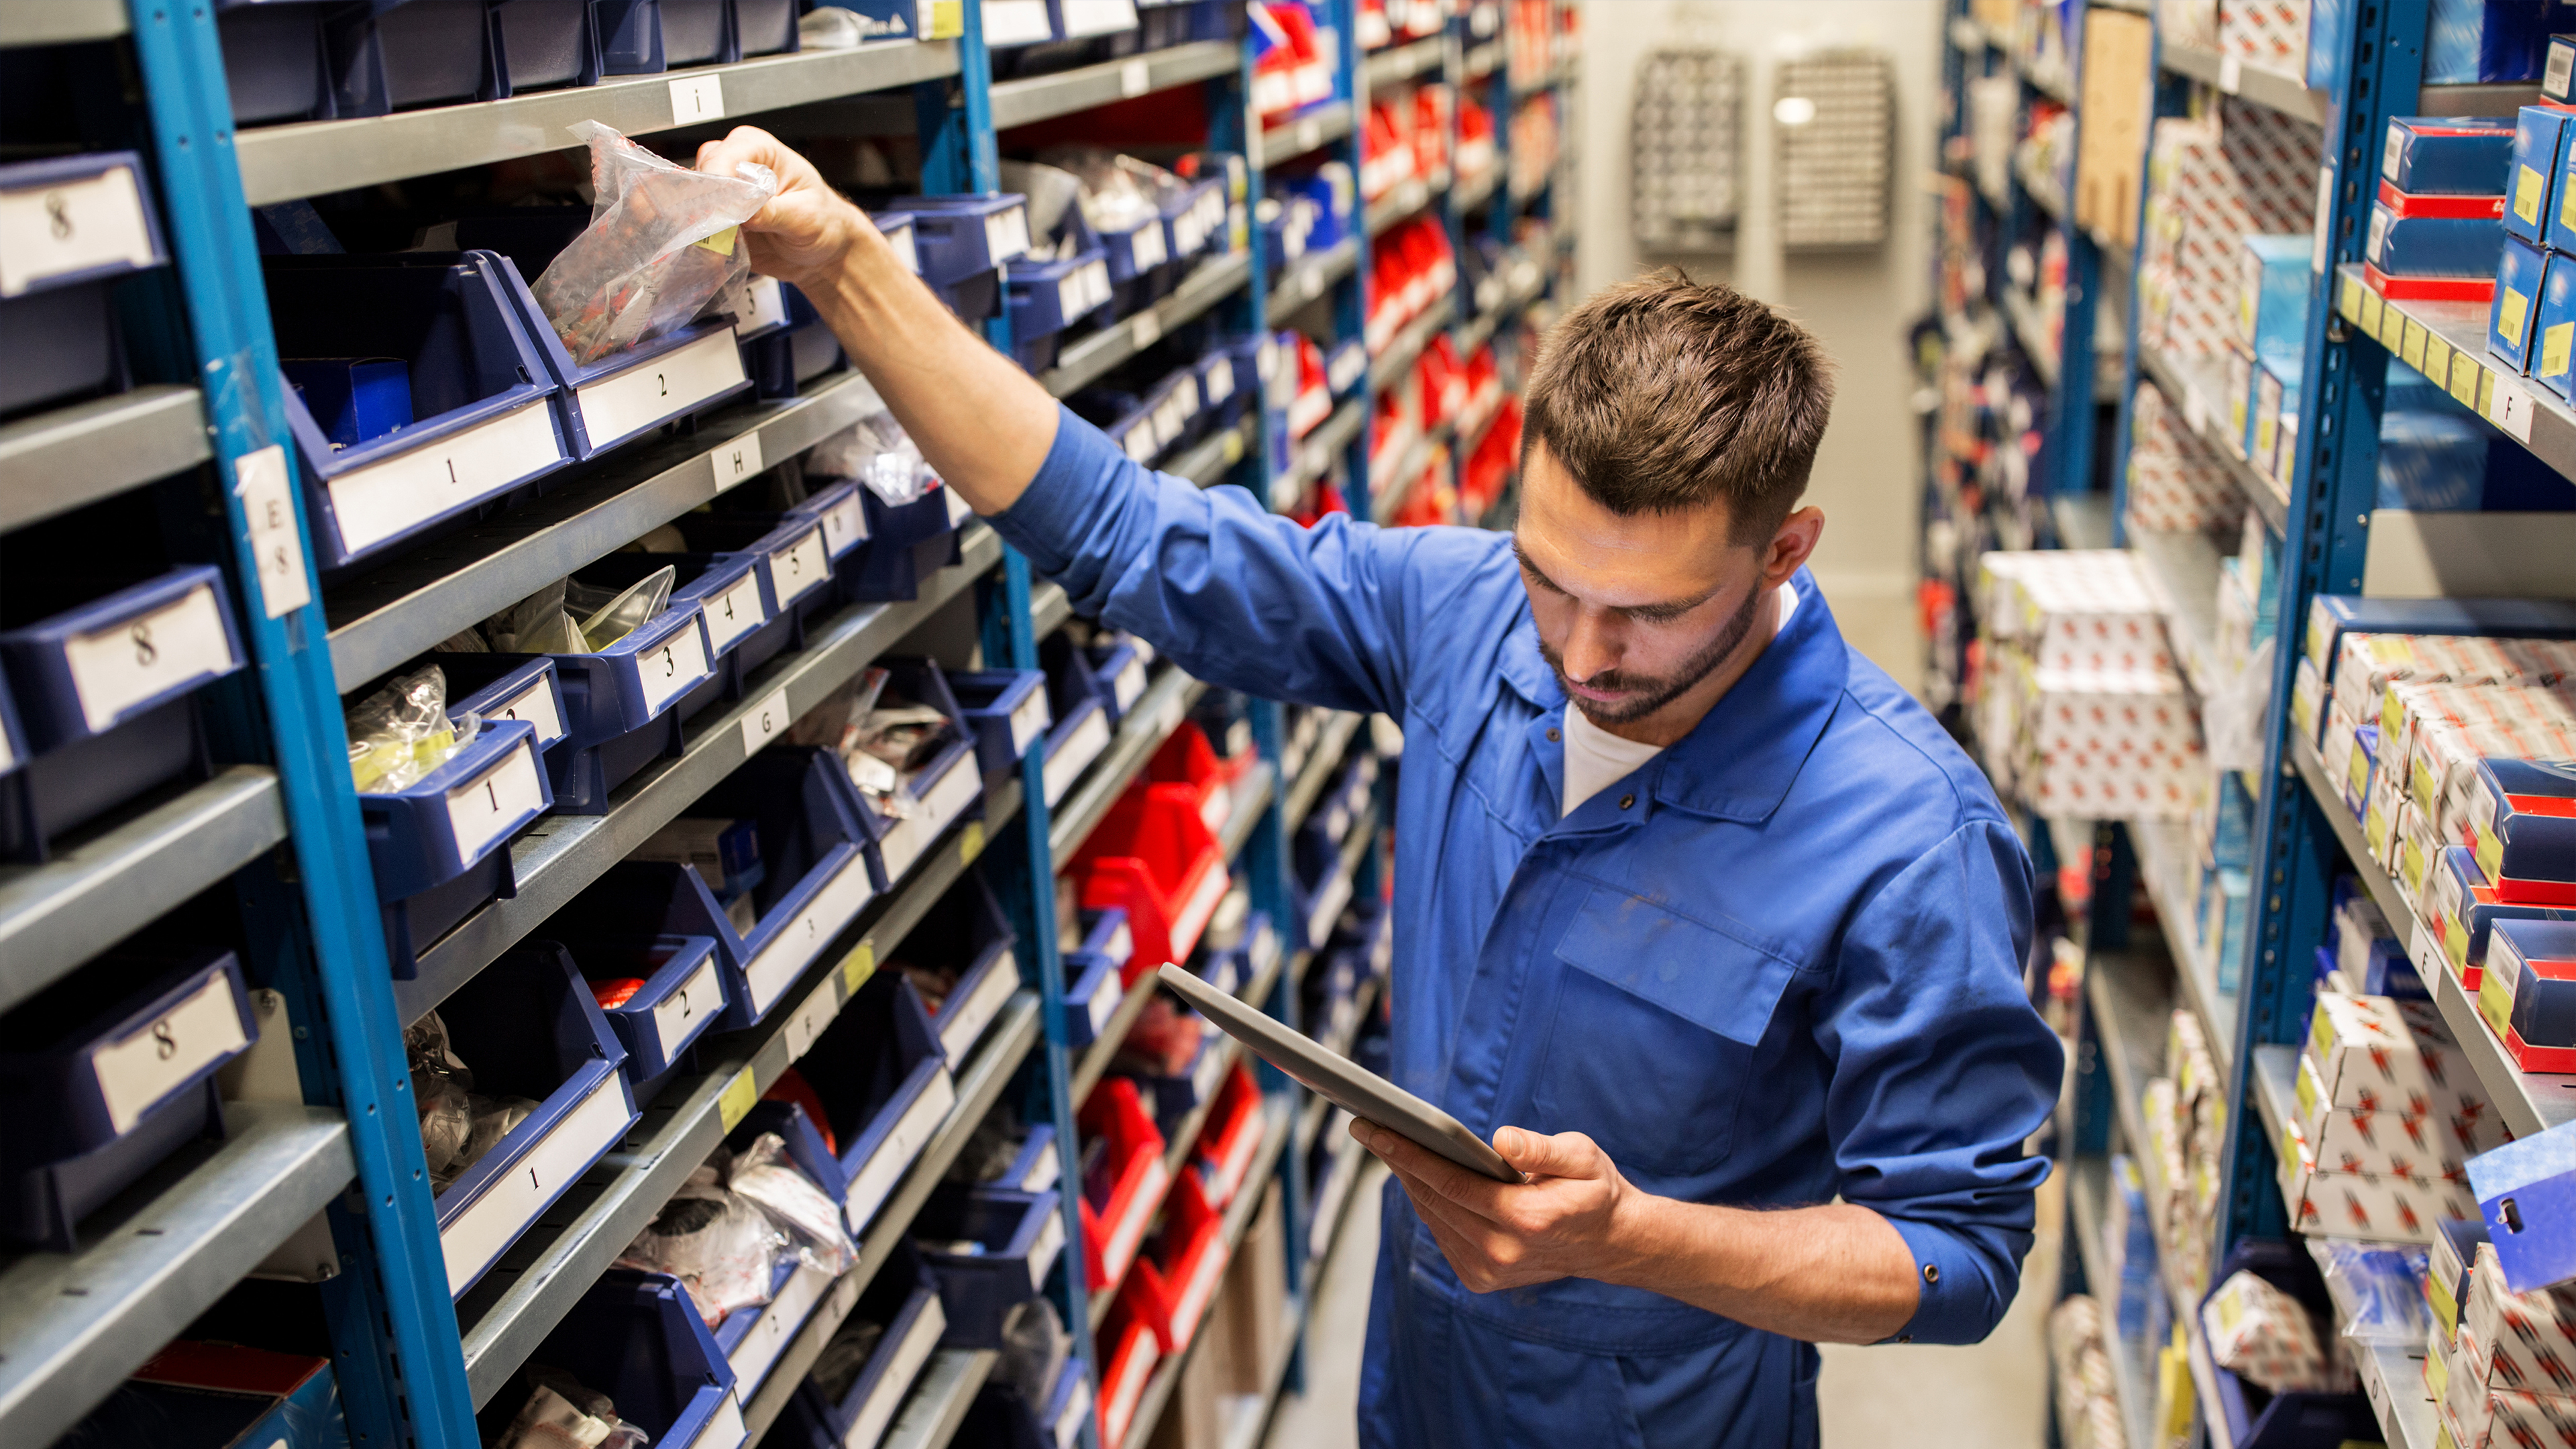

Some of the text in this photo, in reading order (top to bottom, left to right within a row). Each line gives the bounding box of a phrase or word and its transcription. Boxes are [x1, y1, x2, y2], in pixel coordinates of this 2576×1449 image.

[695, 88, 701, 113] i
[45, 189, 74, 242] 8
[745, 286, 756, 315] 3
[657, 374, 667, 397] 2
[2505, 396, 2513, 421] F
[446, 458, 457, 484] 1
[733, 450, 743, 474] H
[266, 498, 284, 529] E
[274, 545, 290, 576] 8
[791, 548, 800, 575] 5
[725, 594, 734, 620] 4
[131, 623, 159, 667] 8
[663, 646, 674, 677] 3
[762, 712, 771, 733] G
[484, 779, 499, 814] 1
[2422, 951, 2428, 975] E
[679, 989, 691, 1019] 2
[152, 1018, 178, 1061] 8
[529, 1167, 539, 1191] 1
